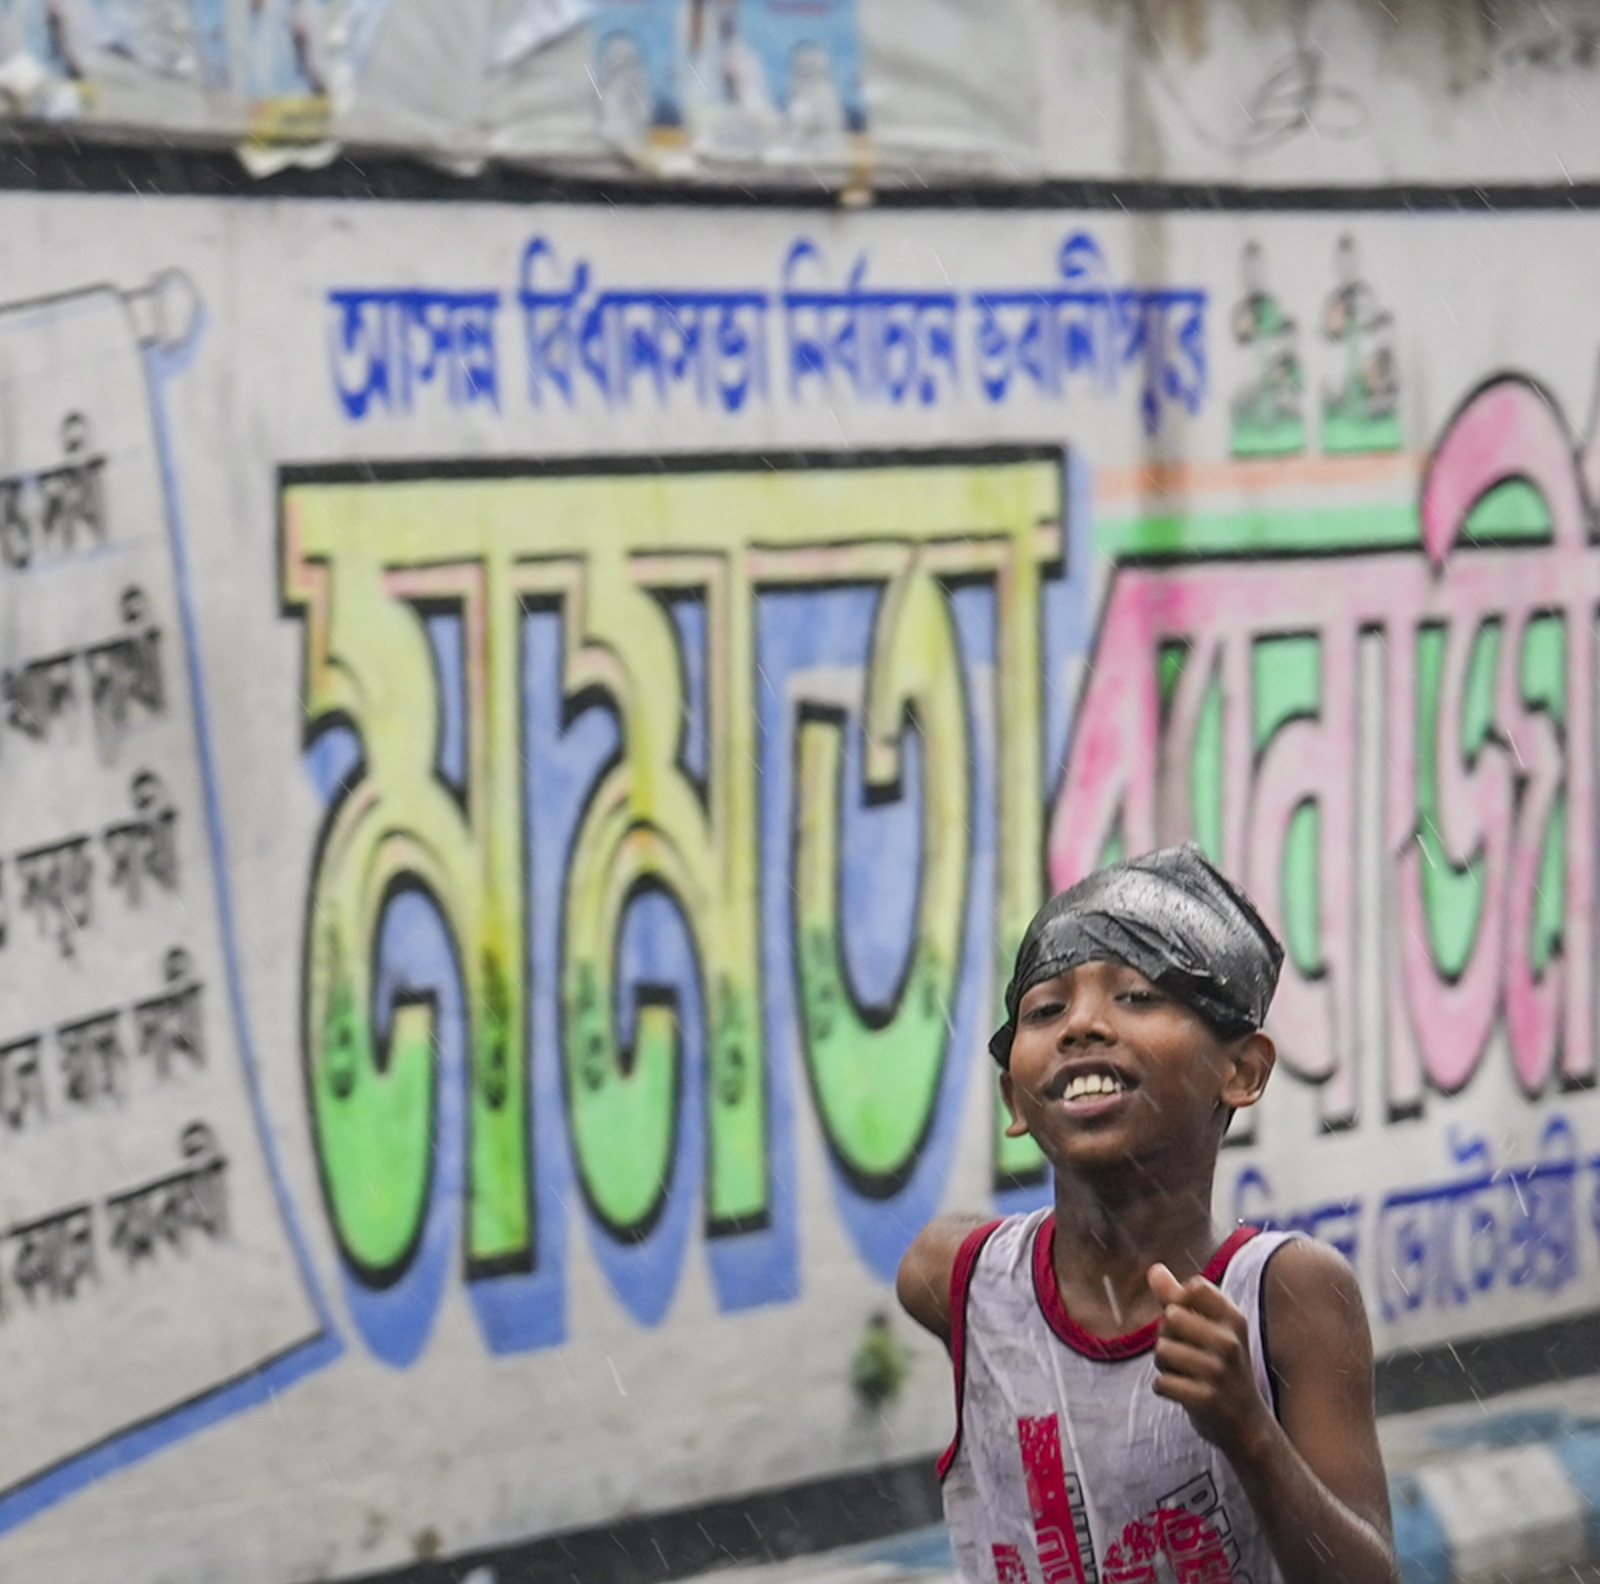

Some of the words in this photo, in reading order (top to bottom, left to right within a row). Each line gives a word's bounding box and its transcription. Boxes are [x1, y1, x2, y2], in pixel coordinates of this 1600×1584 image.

[327, 289, 501, 421] আসন্ন
[518, 236, 767, 414] বিধানসভা
[782, 237, 957, 410] নির্বাচনে
[973, 230, 1207, 436] ভবানীপুরে
[277, 445, 1068, 1292] মমতা
